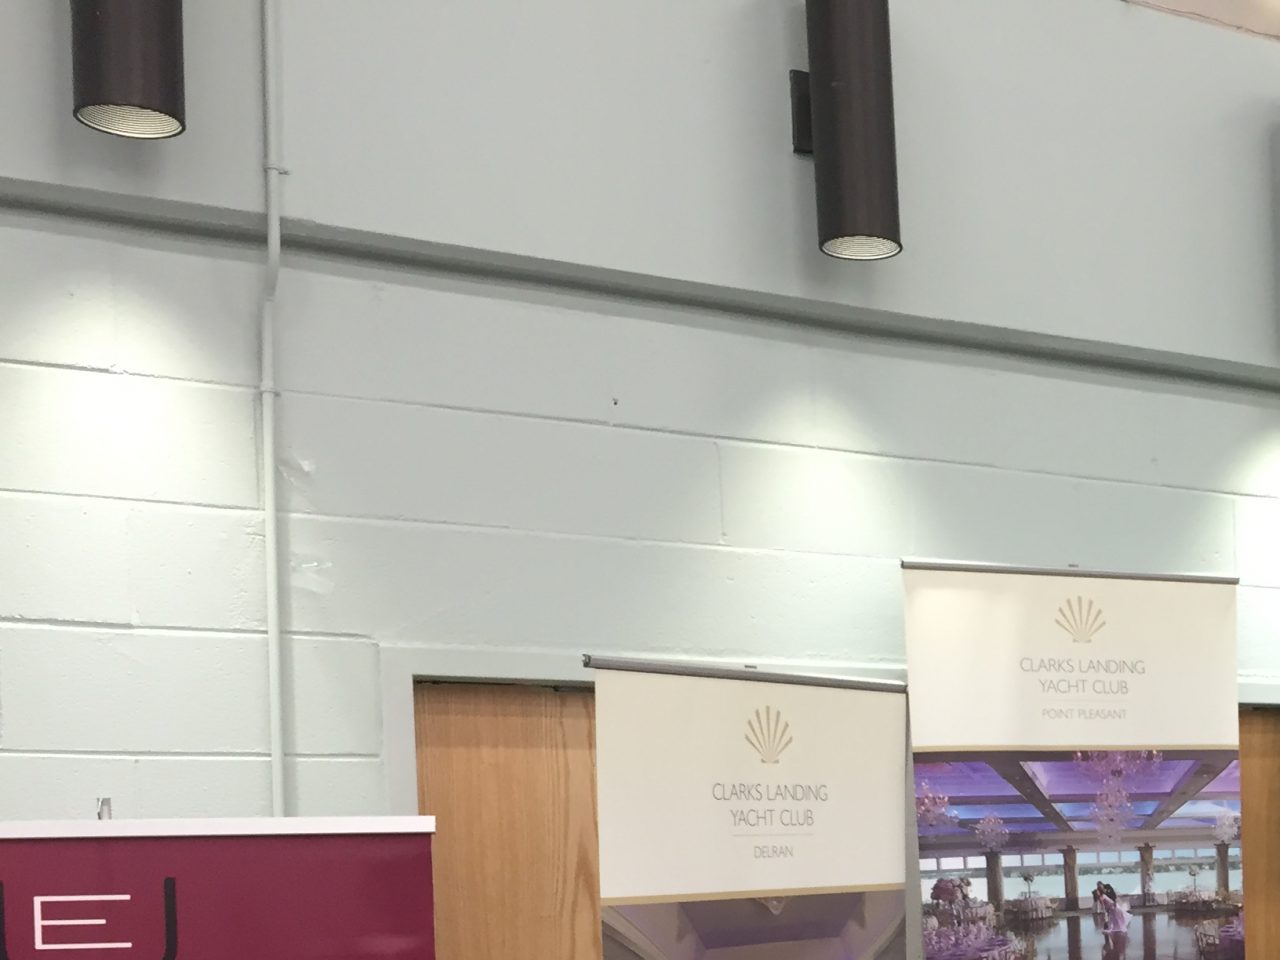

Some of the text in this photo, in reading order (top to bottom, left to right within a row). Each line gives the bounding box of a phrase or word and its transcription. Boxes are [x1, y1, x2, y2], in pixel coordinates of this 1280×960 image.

[1019, 657, 1146, 674] CLARKS LANDING
[1039, 679, 1128, 695] YACHT CLUB
[1041, 708, 1127, 720] POINT PLEASANT
[712, 782, 828, 802] CLARKS LANDING
[730, 808, 814, 827] YACHT CLUB
[754, 845, 794, 858] DELRAN
